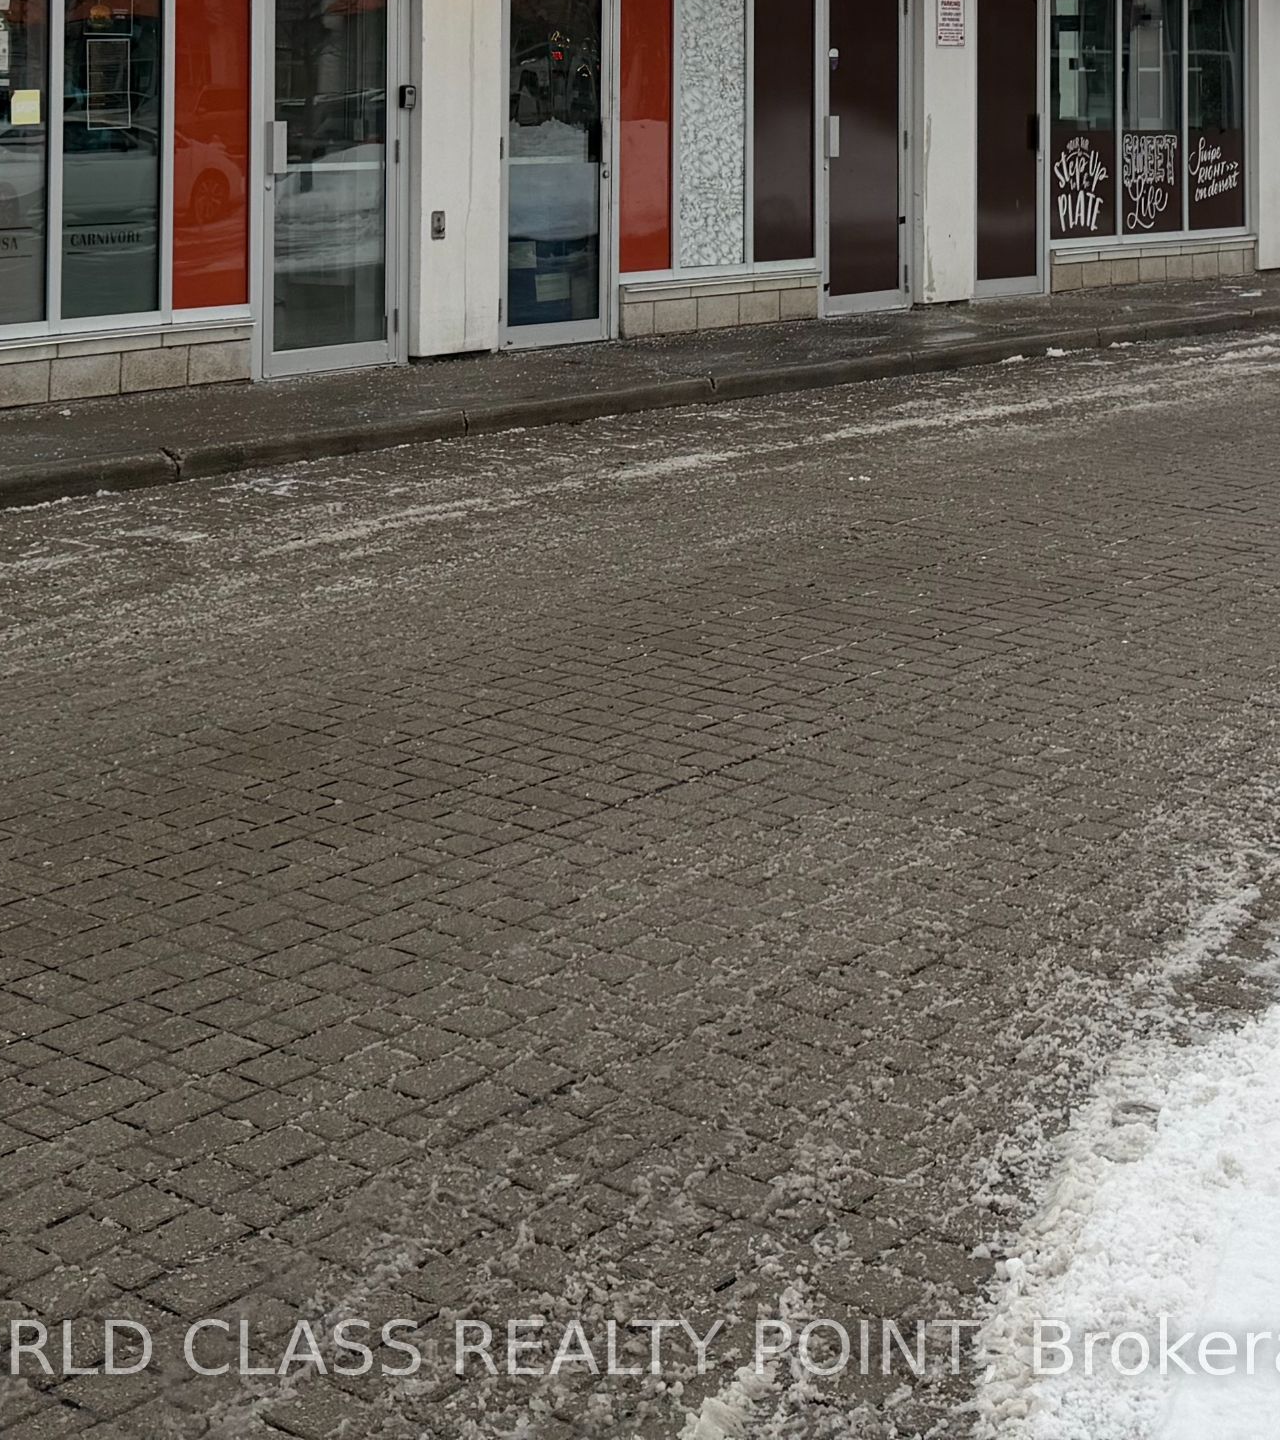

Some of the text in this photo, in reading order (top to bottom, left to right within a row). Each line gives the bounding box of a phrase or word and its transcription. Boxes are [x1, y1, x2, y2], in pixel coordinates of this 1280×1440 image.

[1123, 134, 1178, 187] SWEET
[1197, 160, 1227, 184] RIGHT
[1057, 190, 1104, 232] PLATE
[70, 230, 144, 247] CARNIVORE
